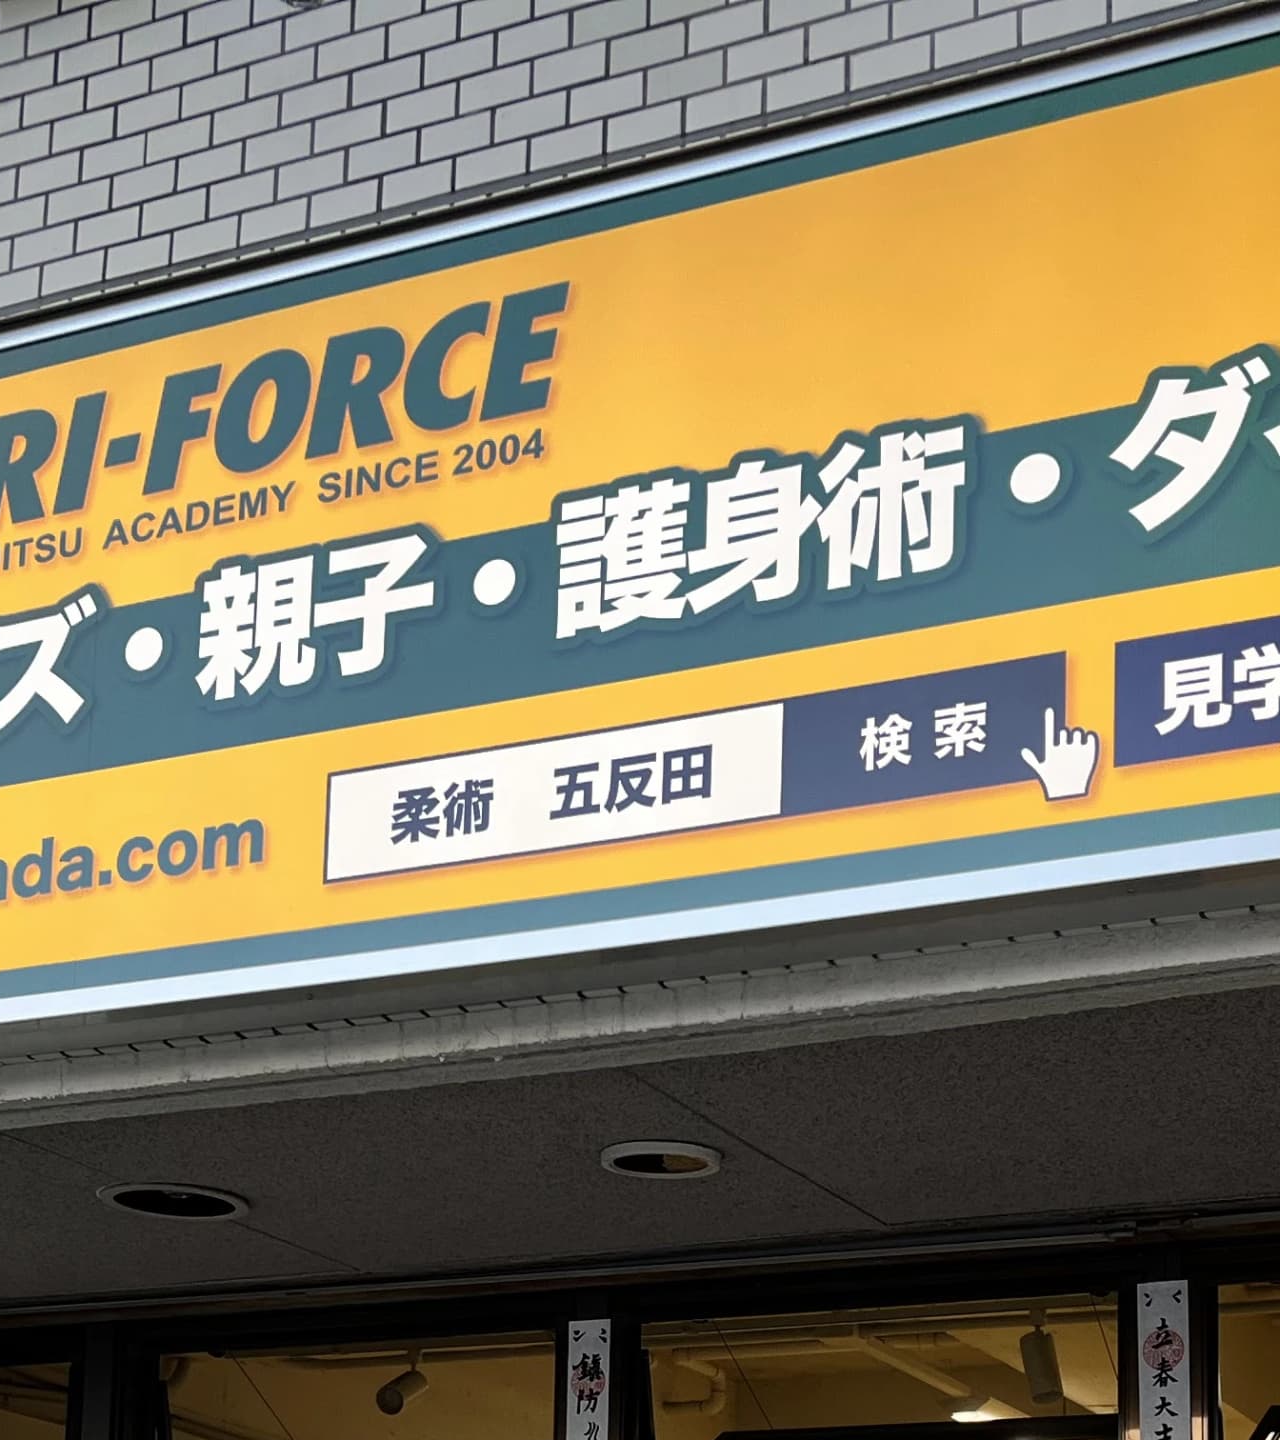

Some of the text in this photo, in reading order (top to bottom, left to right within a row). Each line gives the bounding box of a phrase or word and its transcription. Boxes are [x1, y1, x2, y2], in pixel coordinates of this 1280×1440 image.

[102, 480, 297, 550] ACADEMY
[317, 440, 440, 504] SINCE
[452, 427, 547, 477] 2004
[391, 745, 714, 846] 柔術 五反田
